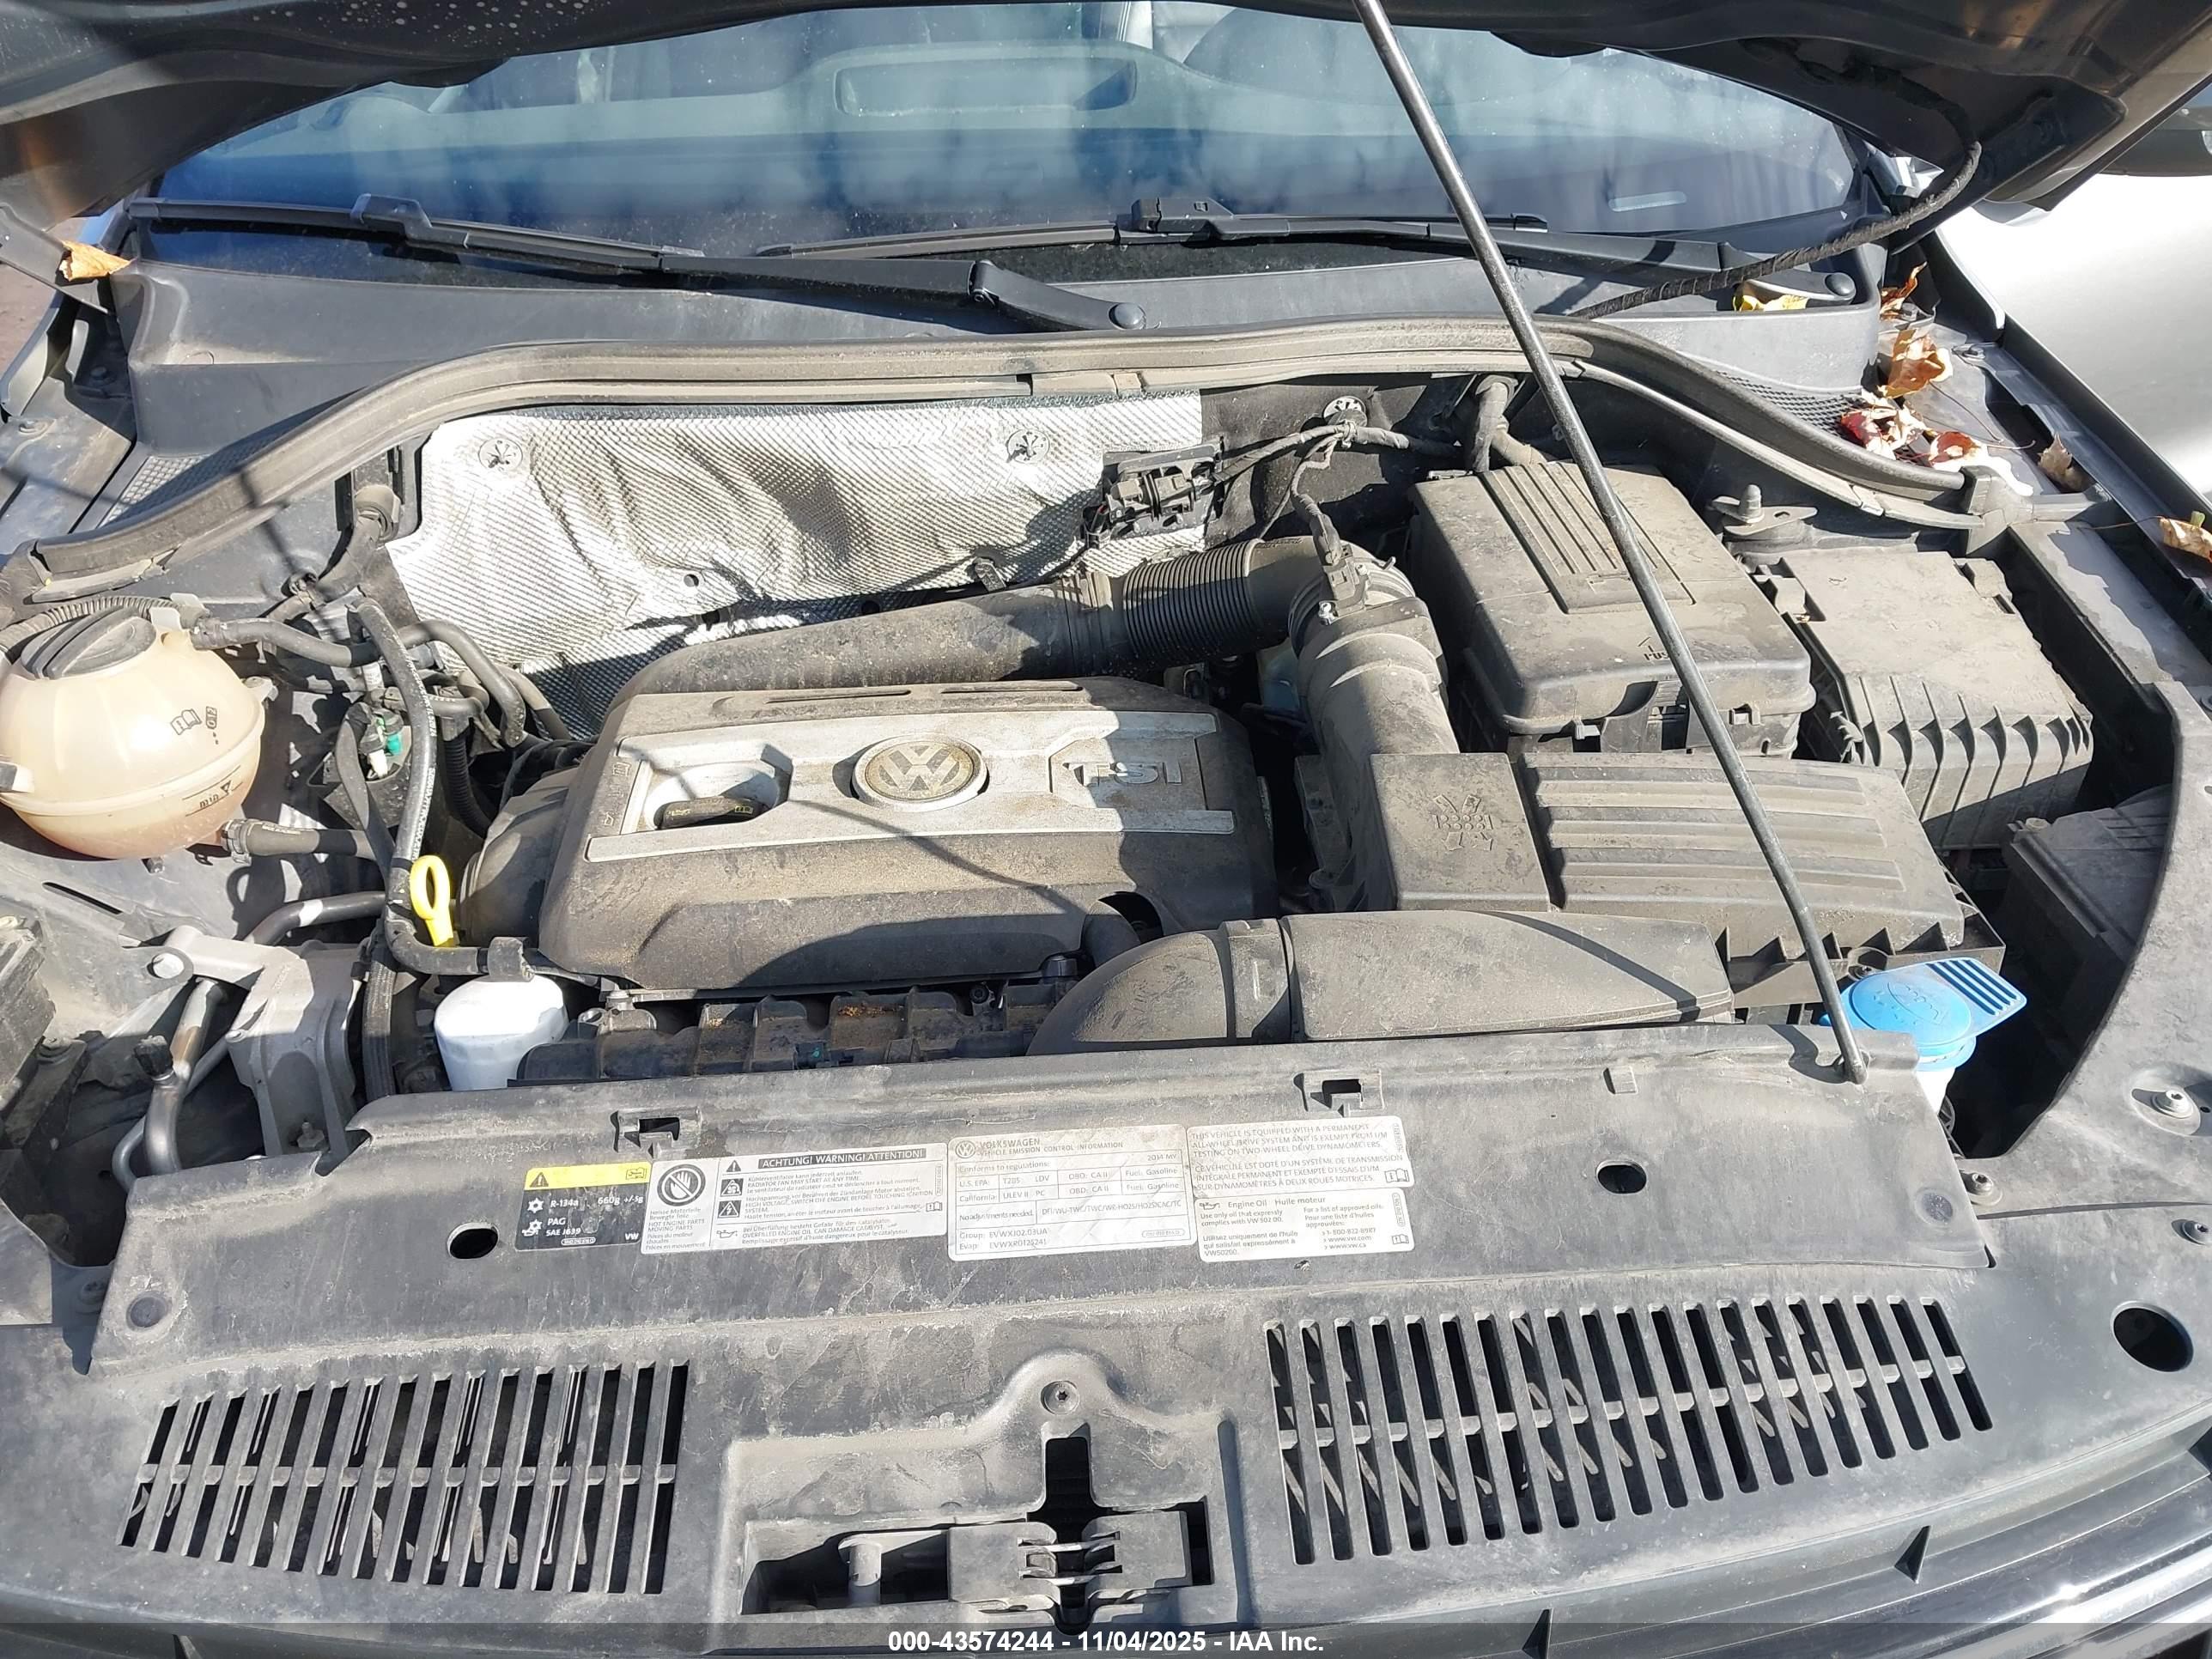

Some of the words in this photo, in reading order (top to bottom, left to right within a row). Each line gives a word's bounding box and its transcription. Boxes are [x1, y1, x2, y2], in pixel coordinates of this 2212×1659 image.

[1061, 761, 1183, 786] TSI
[979, 1139, 1041, 1148] VOLKSWAGEN
[1077, 1142, 1123, 1151] INFORMATION
[763, 1158, 812, 1166] ACHTUNG!
[815, 1154, 866, 1164] WARNING!
[867, 1151, 923, 1160] ATTENTION!
[1346, 1155, 1403, 1164] TRANSMISSION
[550, 1198, 579, 1208] R-134a
[597, 1195, 620, 1206] 660g
[1228, 1200, 1254, 1210] Engine
[1255, 1199, 1267, 1208] Oil
[1274, 1198, 1296, 1206] Huile
[1297, 1196, 1326, 1206] moteur
[1340, 1203, 1370, 1212] approved
[1253, 1208, 1283, 1217] expressly
[547, 1218, 567, 1226] PAG
[545, 1228, 561, 1237] SAE
[562, 1227, 581, 1236] J639
[624, 1232, 640, 1241] VW
